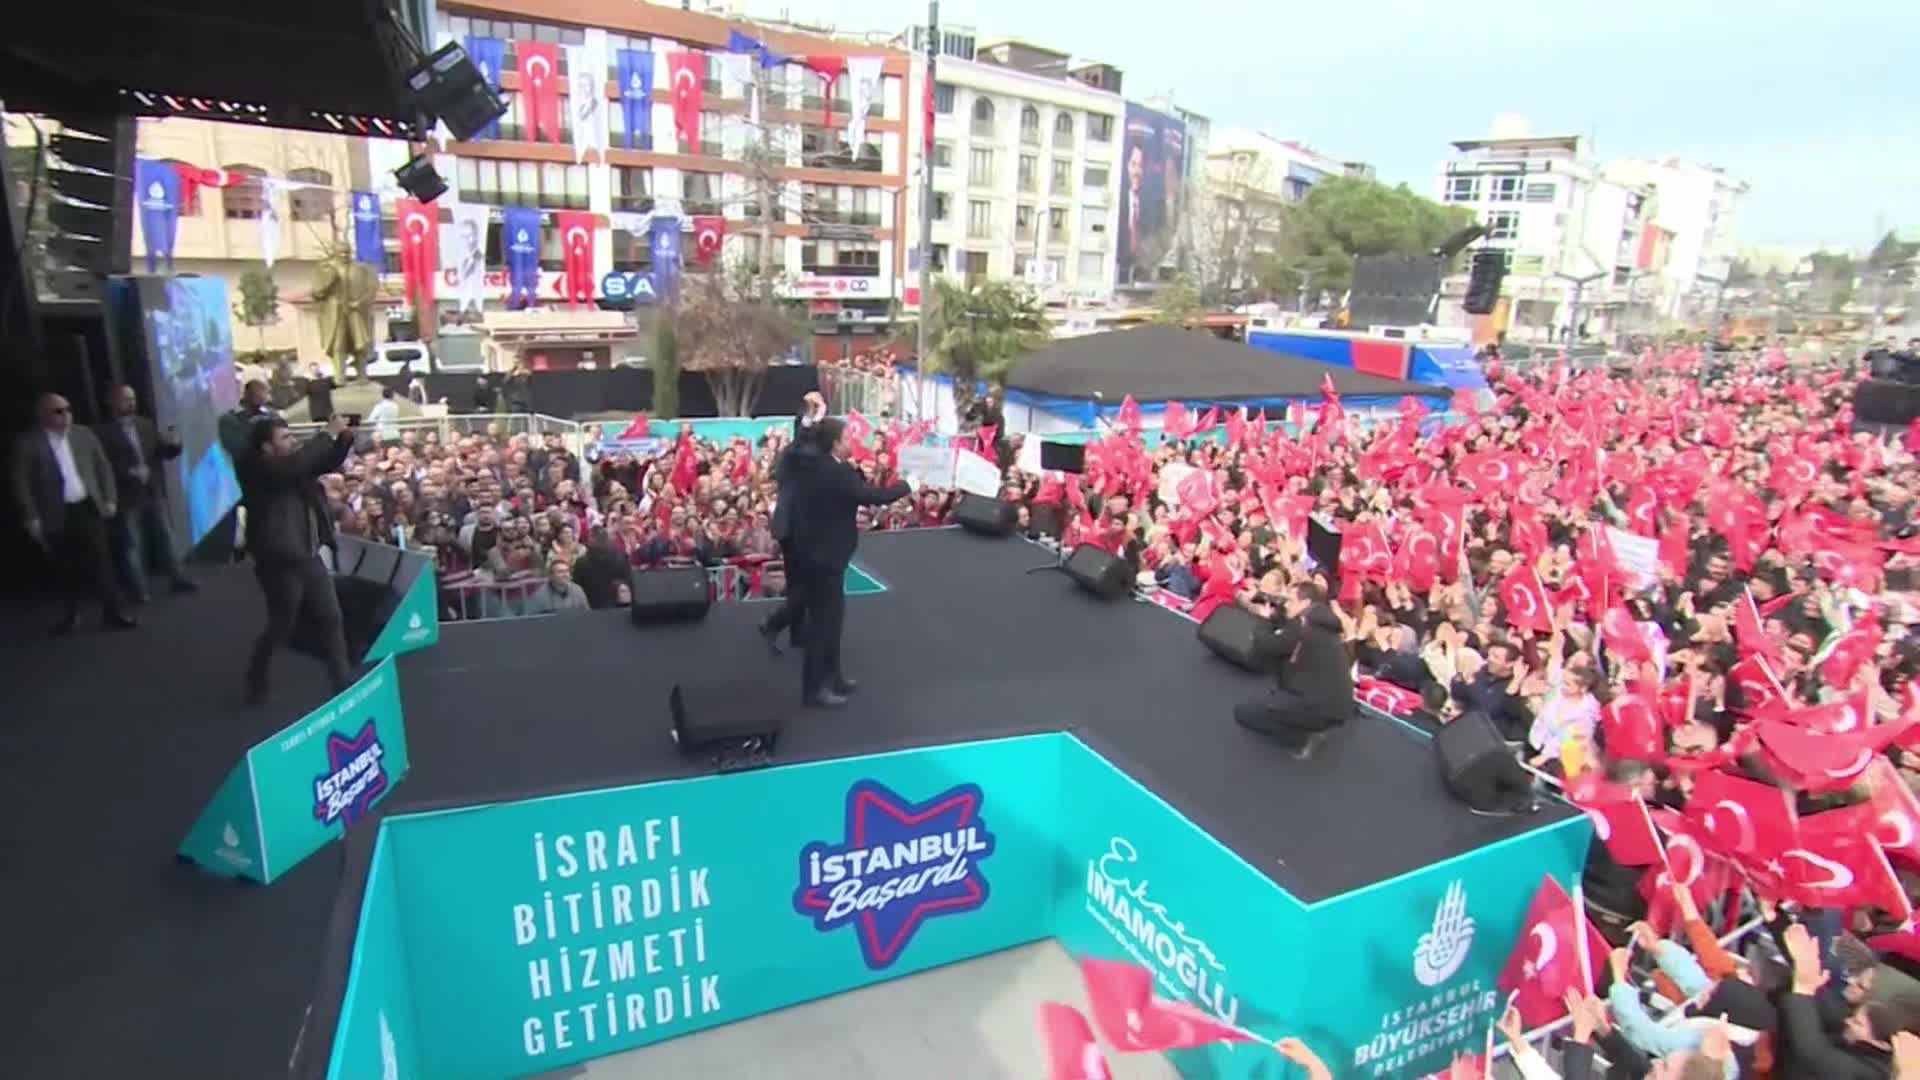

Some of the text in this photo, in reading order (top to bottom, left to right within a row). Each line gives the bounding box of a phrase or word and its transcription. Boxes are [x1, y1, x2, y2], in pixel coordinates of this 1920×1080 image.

[534, 815, 681, 882] İSRAFI
[810, 827, 986, 886] İSTANBUL
[824, 842, 968, 922] Başardı
[513, 866, 711, 945] BİTİRDİK
[1086, 858, 1238, 1025] İMAMOĞLU
[528, 917, 705, 1000] HİZMETİ
[523, 975, 721, 1056] GETİRDİK
[1354, 991, 1498, 1066] BÜYÜKŞEHİR
